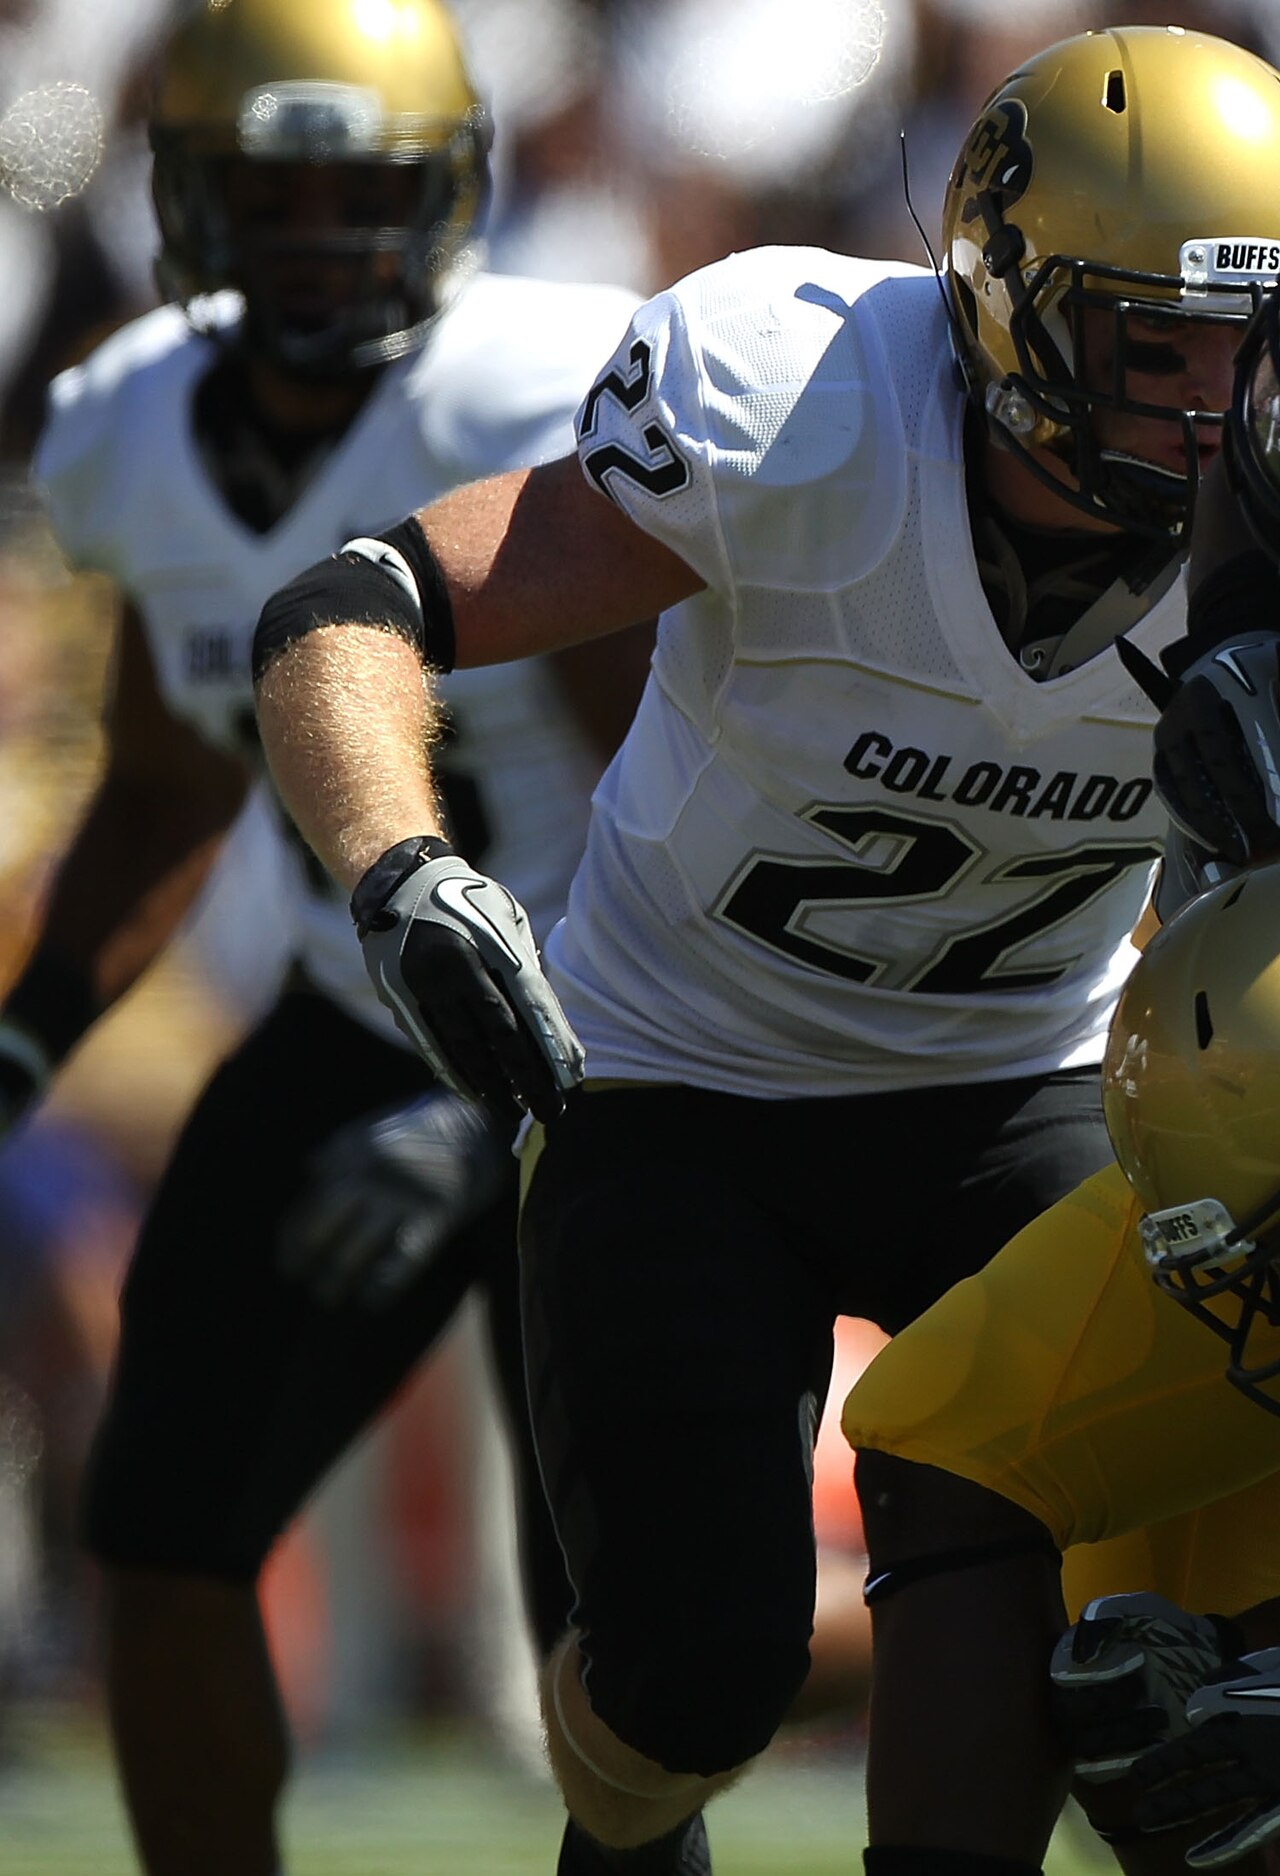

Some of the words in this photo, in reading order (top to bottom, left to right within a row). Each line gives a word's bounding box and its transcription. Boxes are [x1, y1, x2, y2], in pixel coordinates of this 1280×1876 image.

[1215, 243, 1280, 270] BUFFS
[576, 335, 693, 503] 22
[842, 731, 1153, 822] COLORADO
[702, 801, 1166, 995] 22
